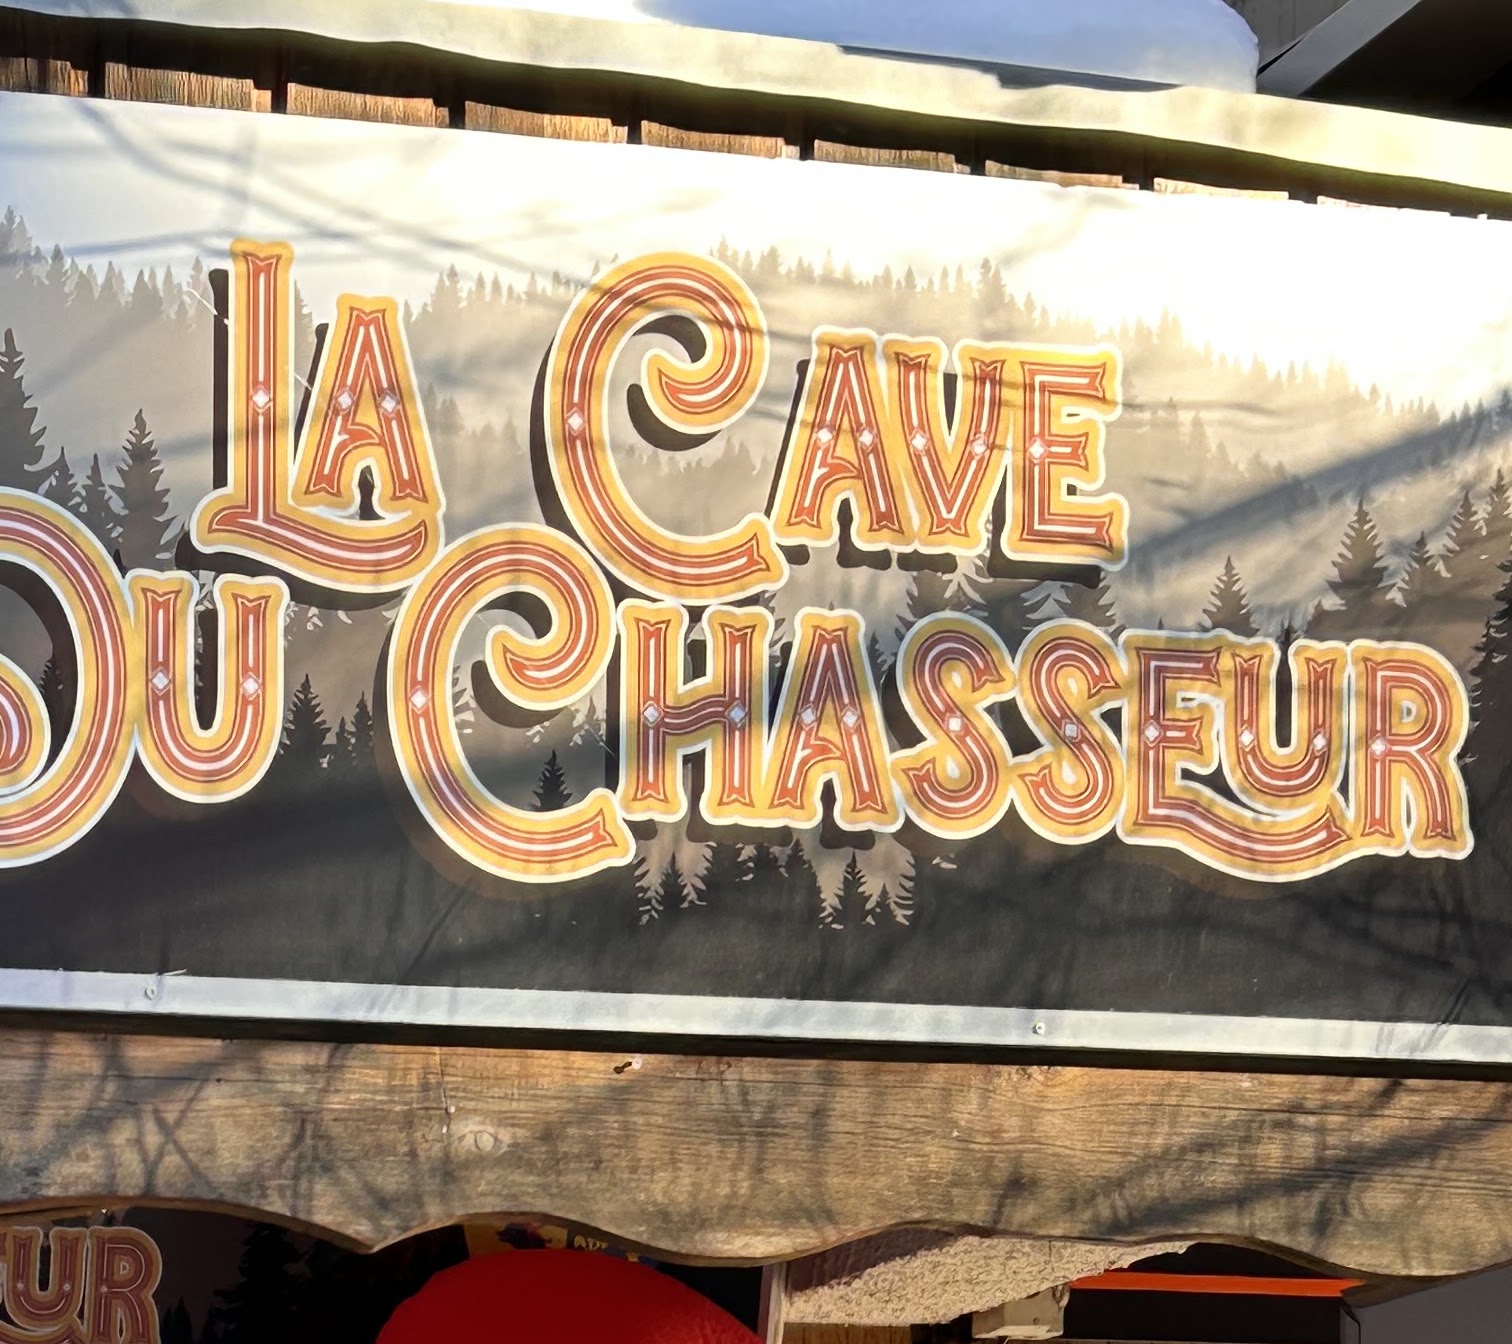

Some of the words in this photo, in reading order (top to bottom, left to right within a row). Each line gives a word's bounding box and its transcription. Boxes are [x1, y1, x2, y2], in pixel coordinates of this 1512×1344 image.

[188, 238, 446, 592] LA
[546, 250, 1130, 601] CAVE
[387, 523, 1476, 884] CHASSEUR
